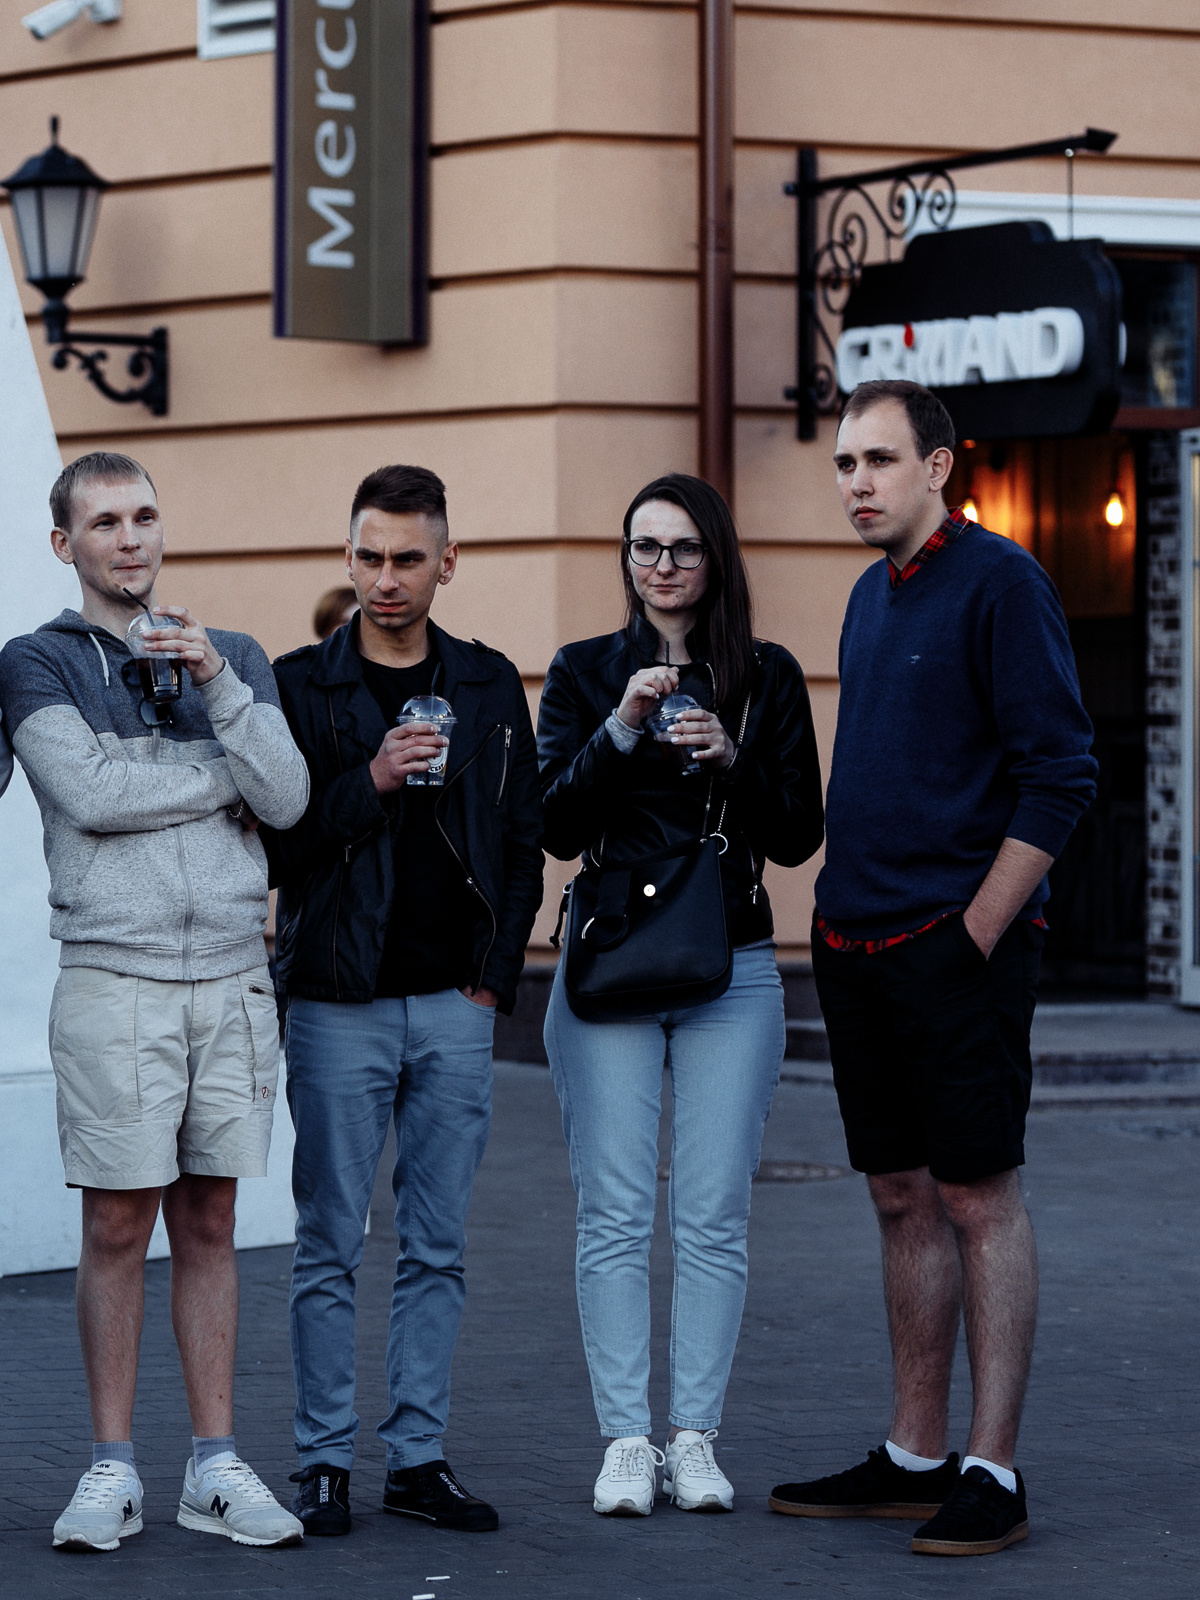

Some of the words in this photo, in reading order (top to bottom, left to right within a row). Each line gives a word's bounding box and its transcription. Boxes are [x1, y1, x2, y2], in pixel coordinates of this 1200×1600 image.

[307, 0, 357, 269] Merc
[319, 1475, 330, 1504] ONVERSE
[210, 1493, 230, 1518] N
